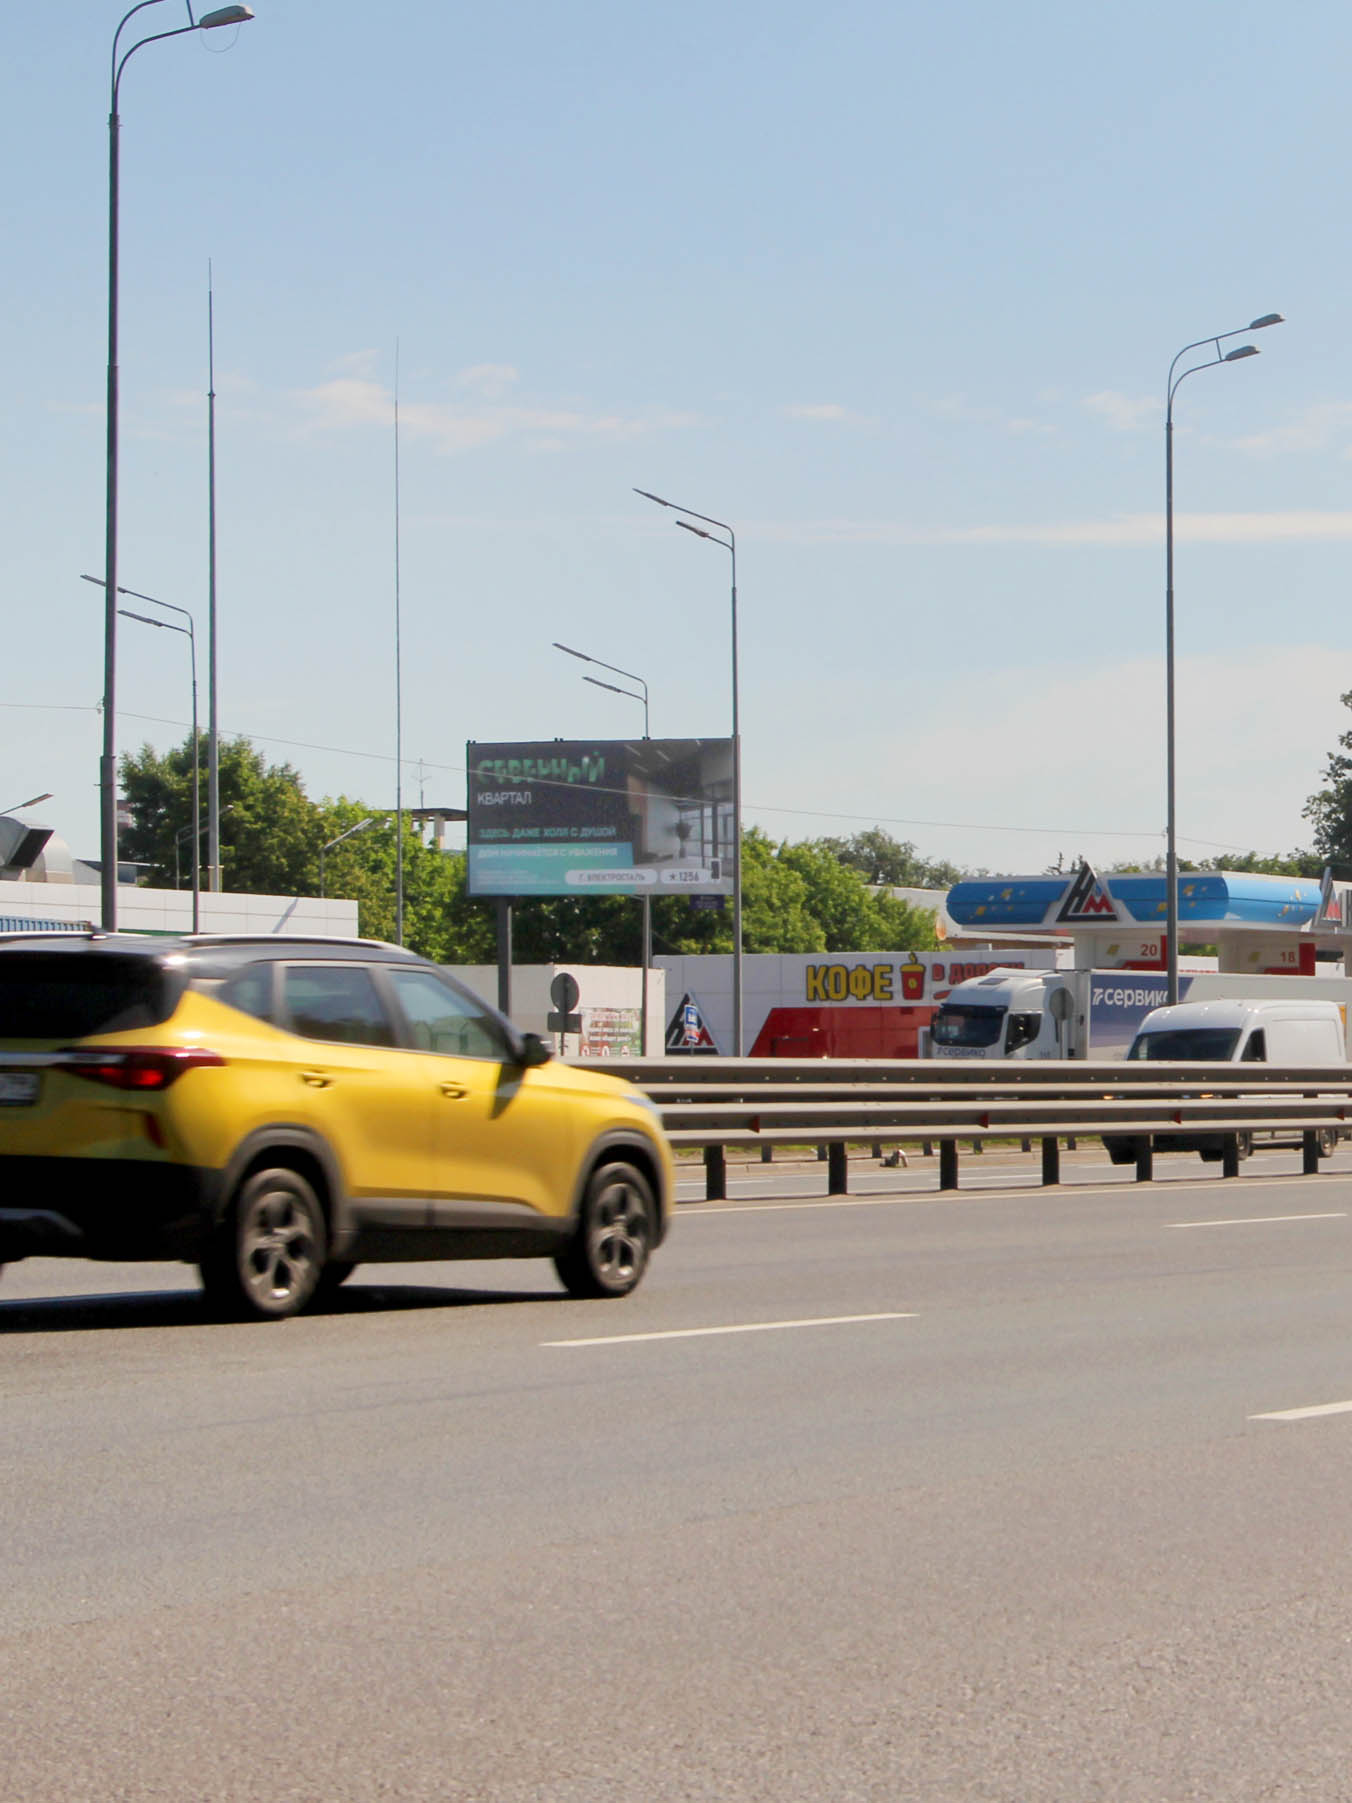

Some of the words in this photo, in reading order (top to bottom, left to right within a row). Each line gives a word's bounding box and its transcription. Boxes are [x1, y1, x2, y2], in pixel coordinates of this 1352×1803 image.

[477, 791, 532, 805] КВАРТАЛ
[1140, 943, 1158, 957] 20
[1280, 952, 1296, 964] 18
[806, 964, 893, 1001] КОФЕ
